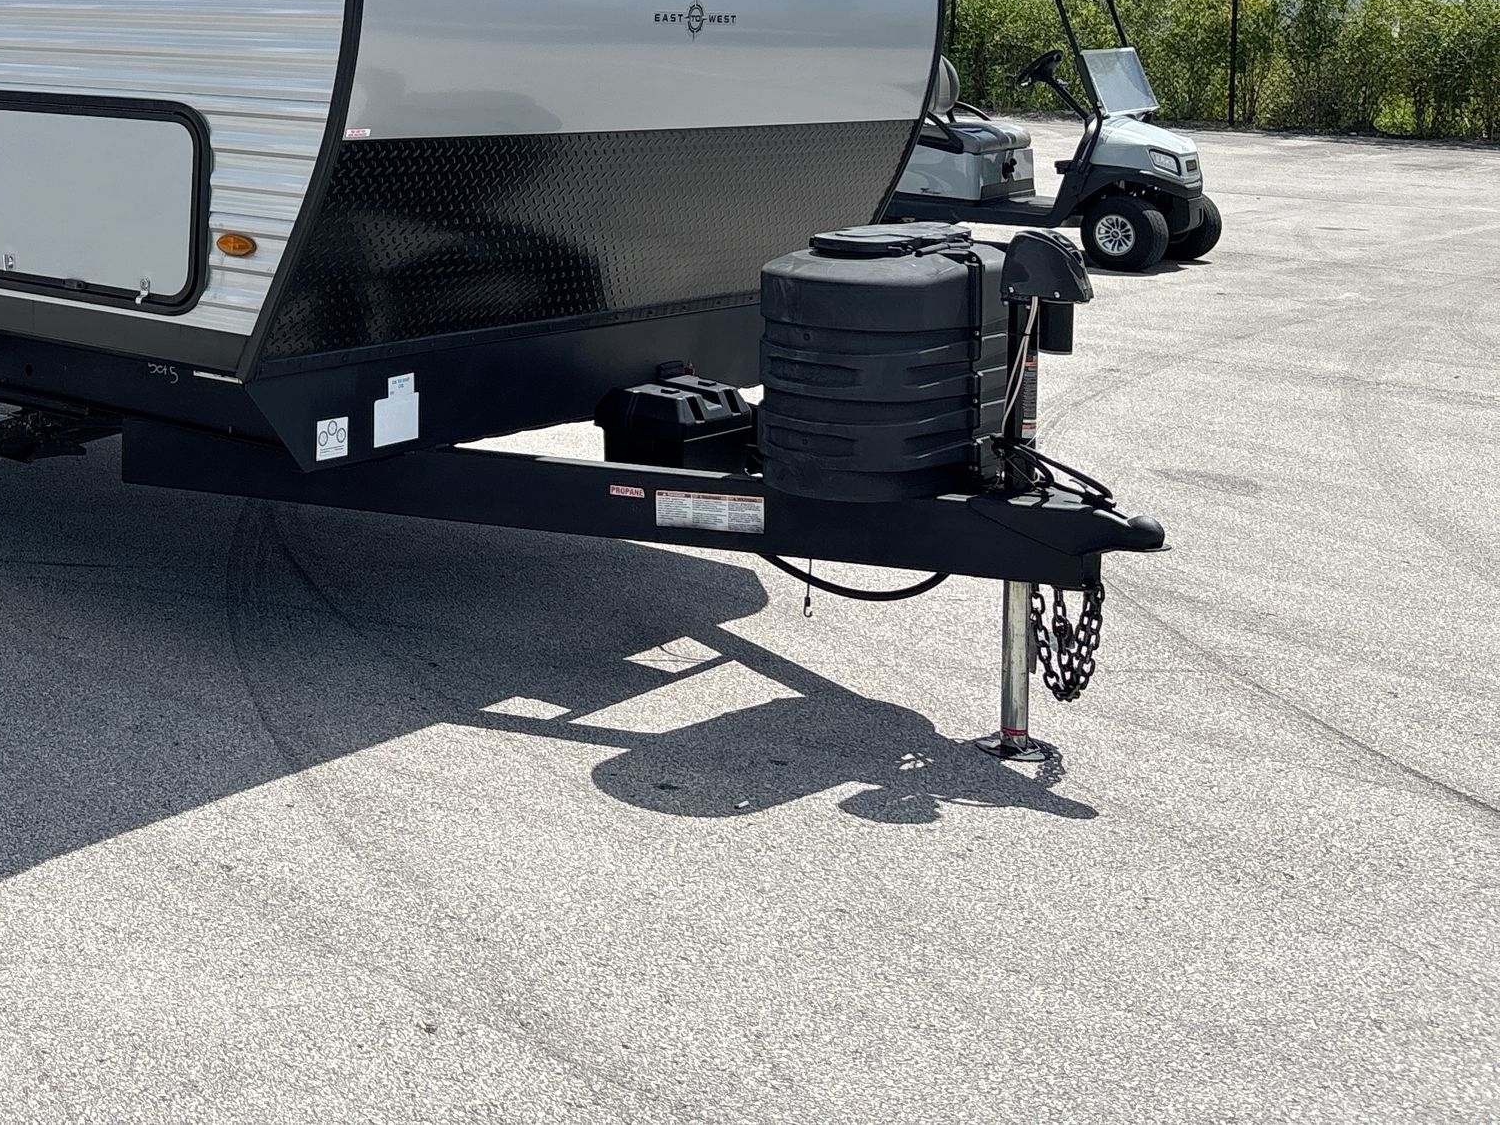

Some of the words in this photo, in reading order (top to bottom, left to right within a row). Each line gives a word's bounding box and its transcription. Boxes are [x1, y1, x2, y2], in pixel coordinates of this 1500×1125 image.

[654, 13, 684, 23] EAST
[690, 15, 702, 23] TO
[708, 15, 737, 24] WEST
[610, 486, 644, 497] PROPANE
